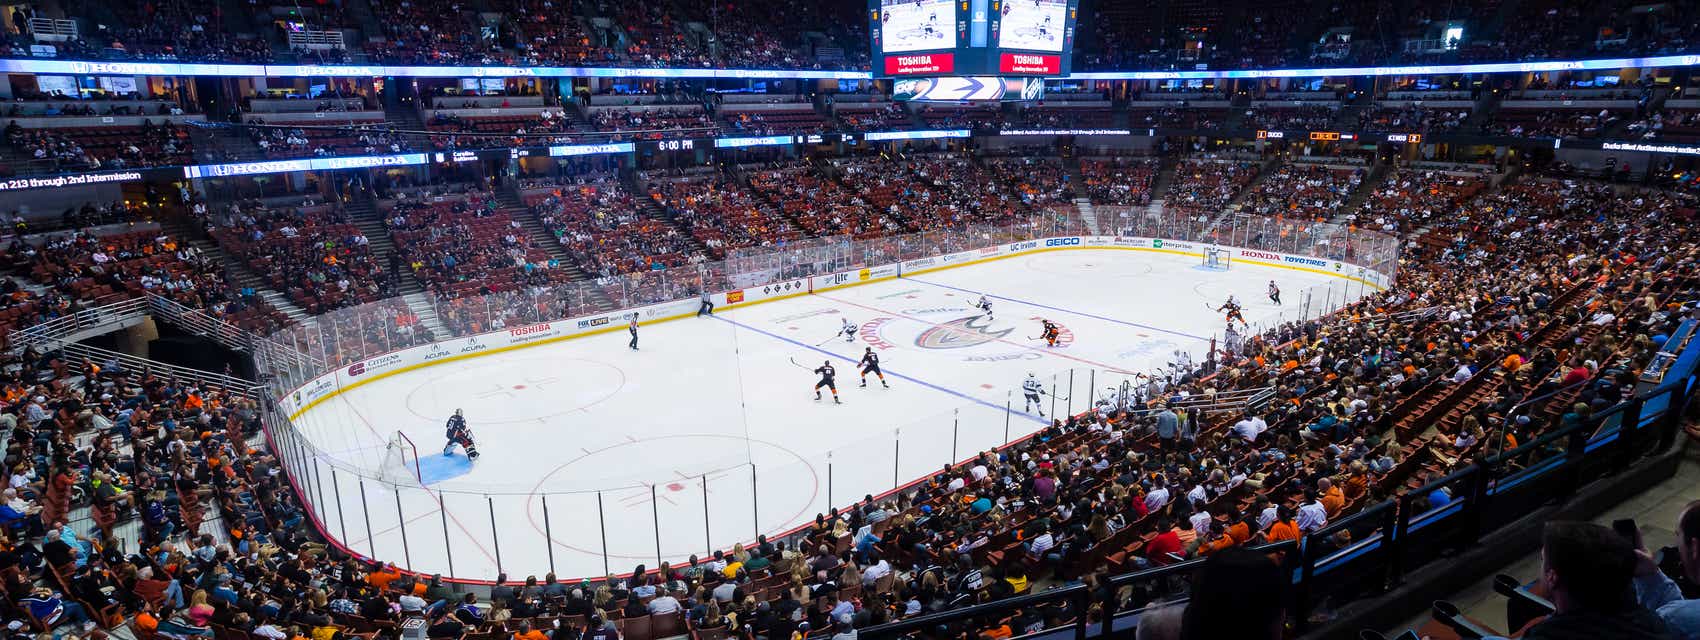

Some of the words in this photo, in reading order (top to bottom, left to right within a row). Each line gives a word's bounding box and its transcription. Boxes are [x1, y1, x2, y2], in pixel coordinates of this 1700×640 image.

[897, 55, 932, 66] TOSHIBA
[1013, 55, 1043, 65] TOSHIBA
[90, 63, 165, 74] HONDA
[310, 67, 373, 76] HONDA
[1387, 134, 1407, 142] KINGS
[574, 145, 621, 155] HONDA
[659, 140, 679, 150] 6:00
[682, 139, 693, 150] PM
[232, 161, 299, 174] HONDA
[344, 156, 408, 168] HONDA
[9, 180, 29, 190] 213
[30, 177, 67, 189] through
[68, 174, 85, 186] 2nd
[86, 171, 141, 184] Intermission
[1010, 244, 1019, 252] UC
[1020, 241, 1037, 250] Irvine
[1046, 237, 1080, 247] GEICO
[1240, 250, 1281, 261] HONDA
[1284, 256, 1307, 264] TOYO
[1306, 259, 1327, 267] TIRES
[834, 273, 849, 285] Lite
[510, 323, 552, 336] TOSHIBA
[461, 344, 487, 353] ACURA
[424, 350, 450, 360] ACURA
